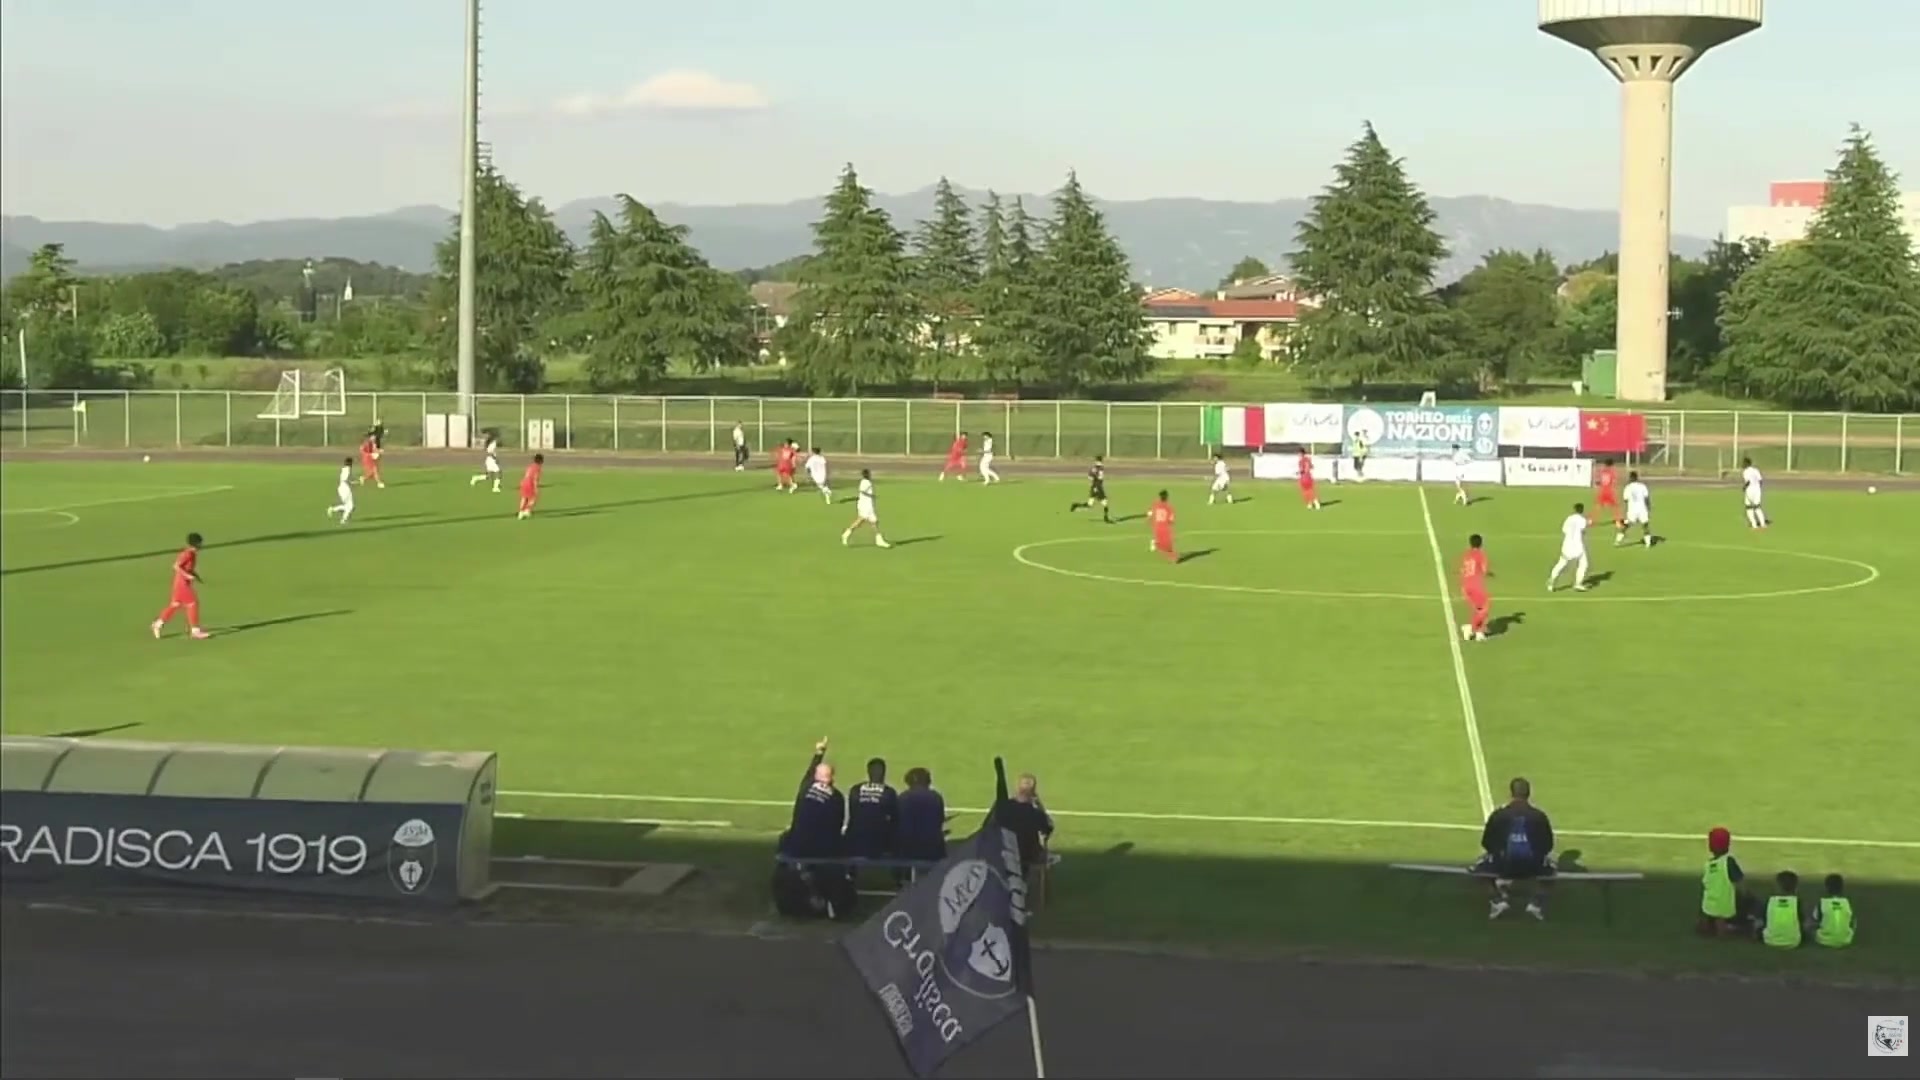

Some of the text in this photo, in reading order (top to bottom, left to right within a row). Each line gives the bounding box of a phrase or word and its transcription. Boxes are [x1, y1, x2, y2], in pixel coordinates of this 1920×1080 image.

[1385, 411, 1444, 423] TORNEO
[1387, 424, 1473, 441] NAZIONI
[0, 824, 367, 875] RADISCA 1919
